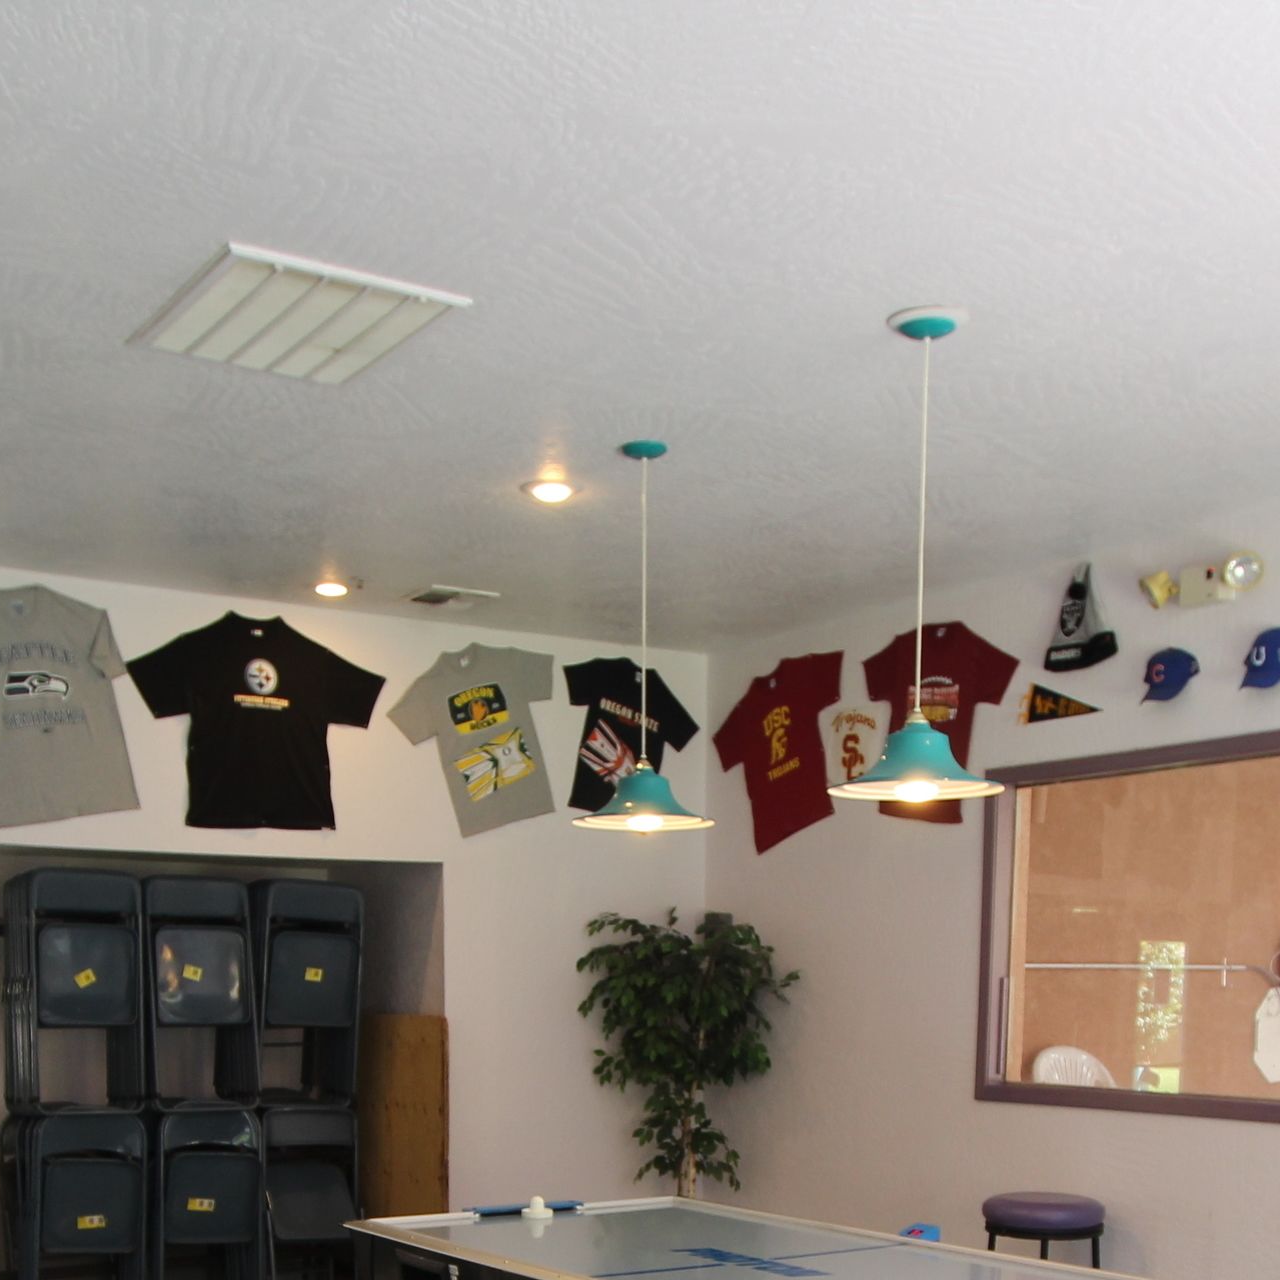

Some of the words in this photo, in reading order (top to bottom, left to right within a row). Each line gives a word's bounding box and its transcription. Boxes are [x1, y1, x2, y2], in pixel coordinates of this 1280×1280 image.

[1151, 662, 1166, 683] C
[454, 686, 496, 707] OREGON
[600, 697, 634, 720] OREGON
[763, 705, 791, 736] USC
[832, 708, 876, 733] Trojans
